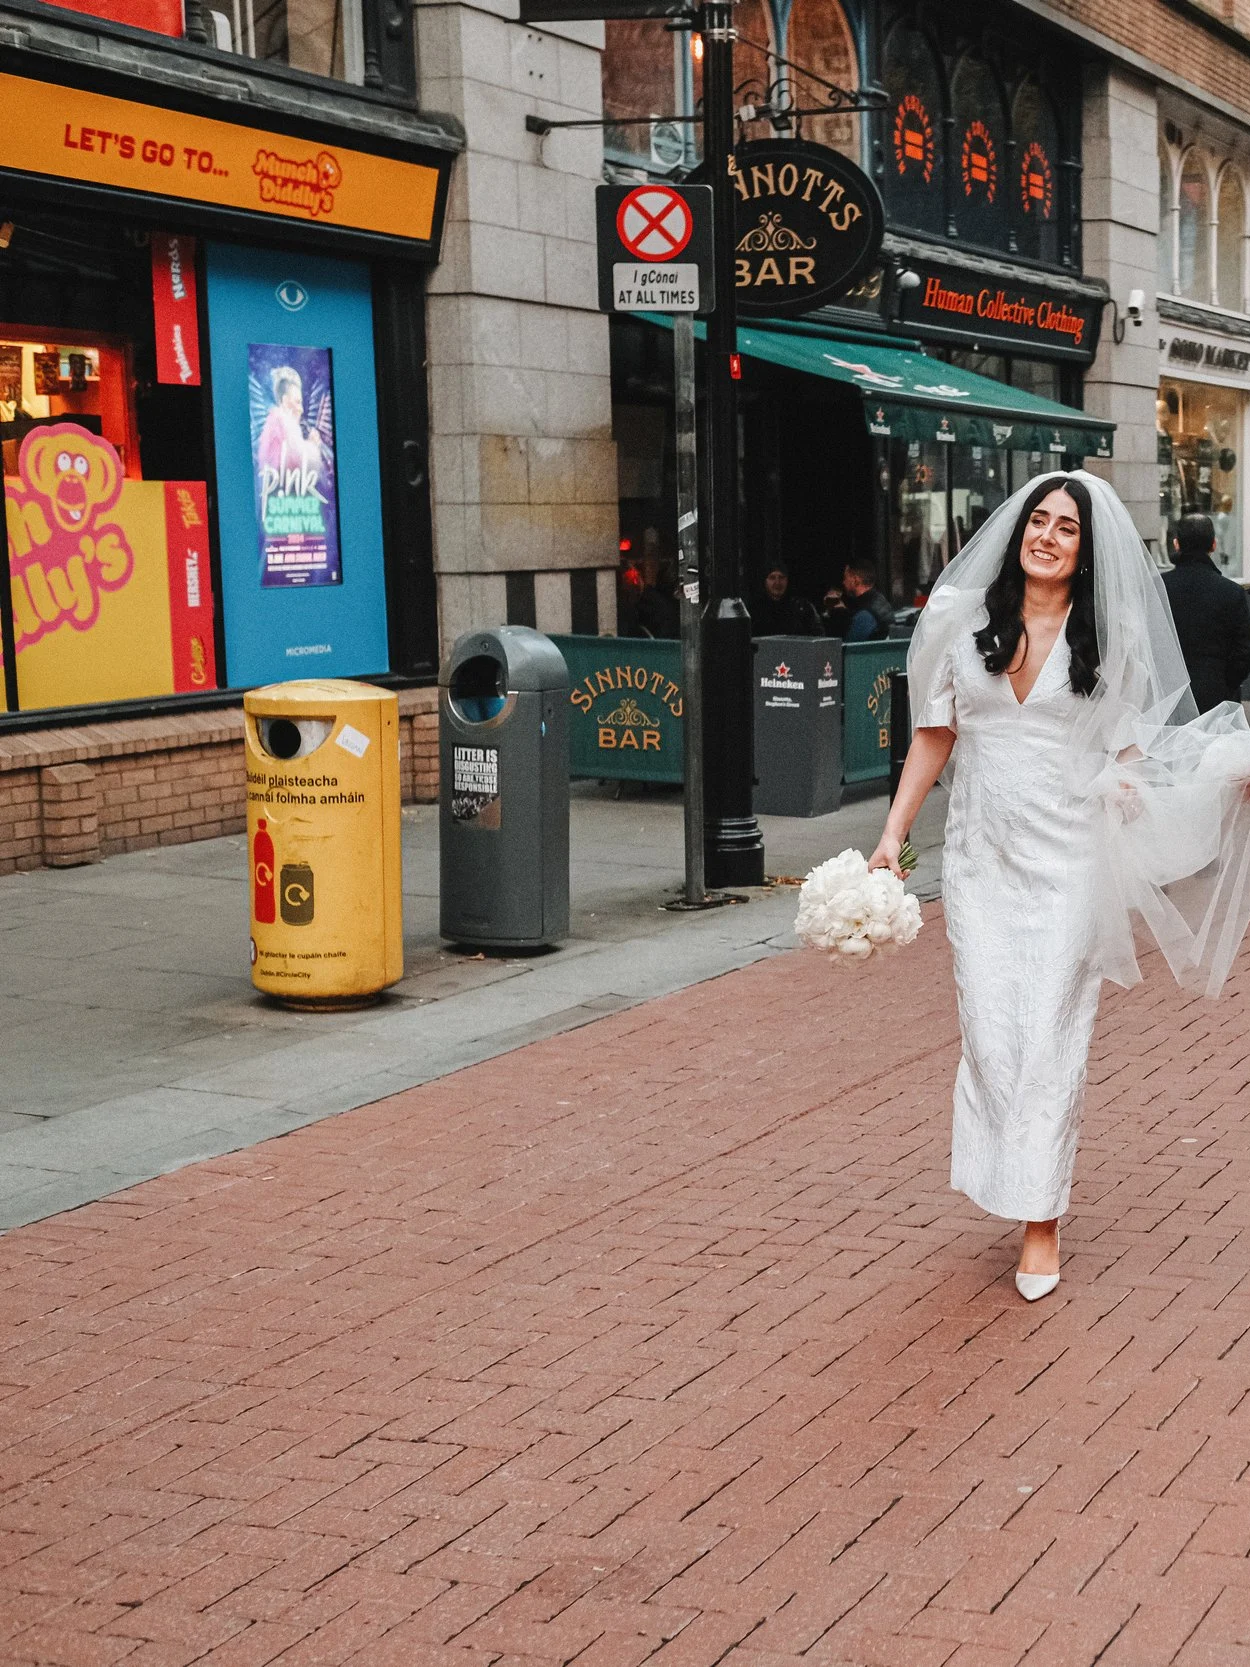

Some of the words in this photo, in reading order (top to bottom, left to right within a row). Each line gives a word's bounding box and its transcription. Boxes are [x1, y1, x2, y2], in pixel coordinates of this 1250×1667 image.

[64, 123, 135, 159] LET'S
[142, 140, 175, 167] GO
[633, 269, 638, 284] I
[735, 256, 817, 287] BAR
[618, 290, 632, 304] AT
[635, 290, 657, 304] ALL
[660, 290, 695, 304] TIMES
[923, 277, 974, 315] Human
[976, 288, 1035, 326] Collective
[1036, 301, 1085, 345] Clothing
[285, 644, 332, 656] MICROMEDIA
[760, 677, 804, 690] Heineken
[598, 727, 661, 751] BAR
[454, 746, 484, 761] LITTER
[486, 748, 498, 763] IS
[454, 760, 498, 773] DISGUSTING
[268, 774, 338, 788] plaisteacha
[454, 781, 498, 794] RESPONSIBLE
[276, 792, 316, 805] folmha
[319, 791, 365, 805] amháin
